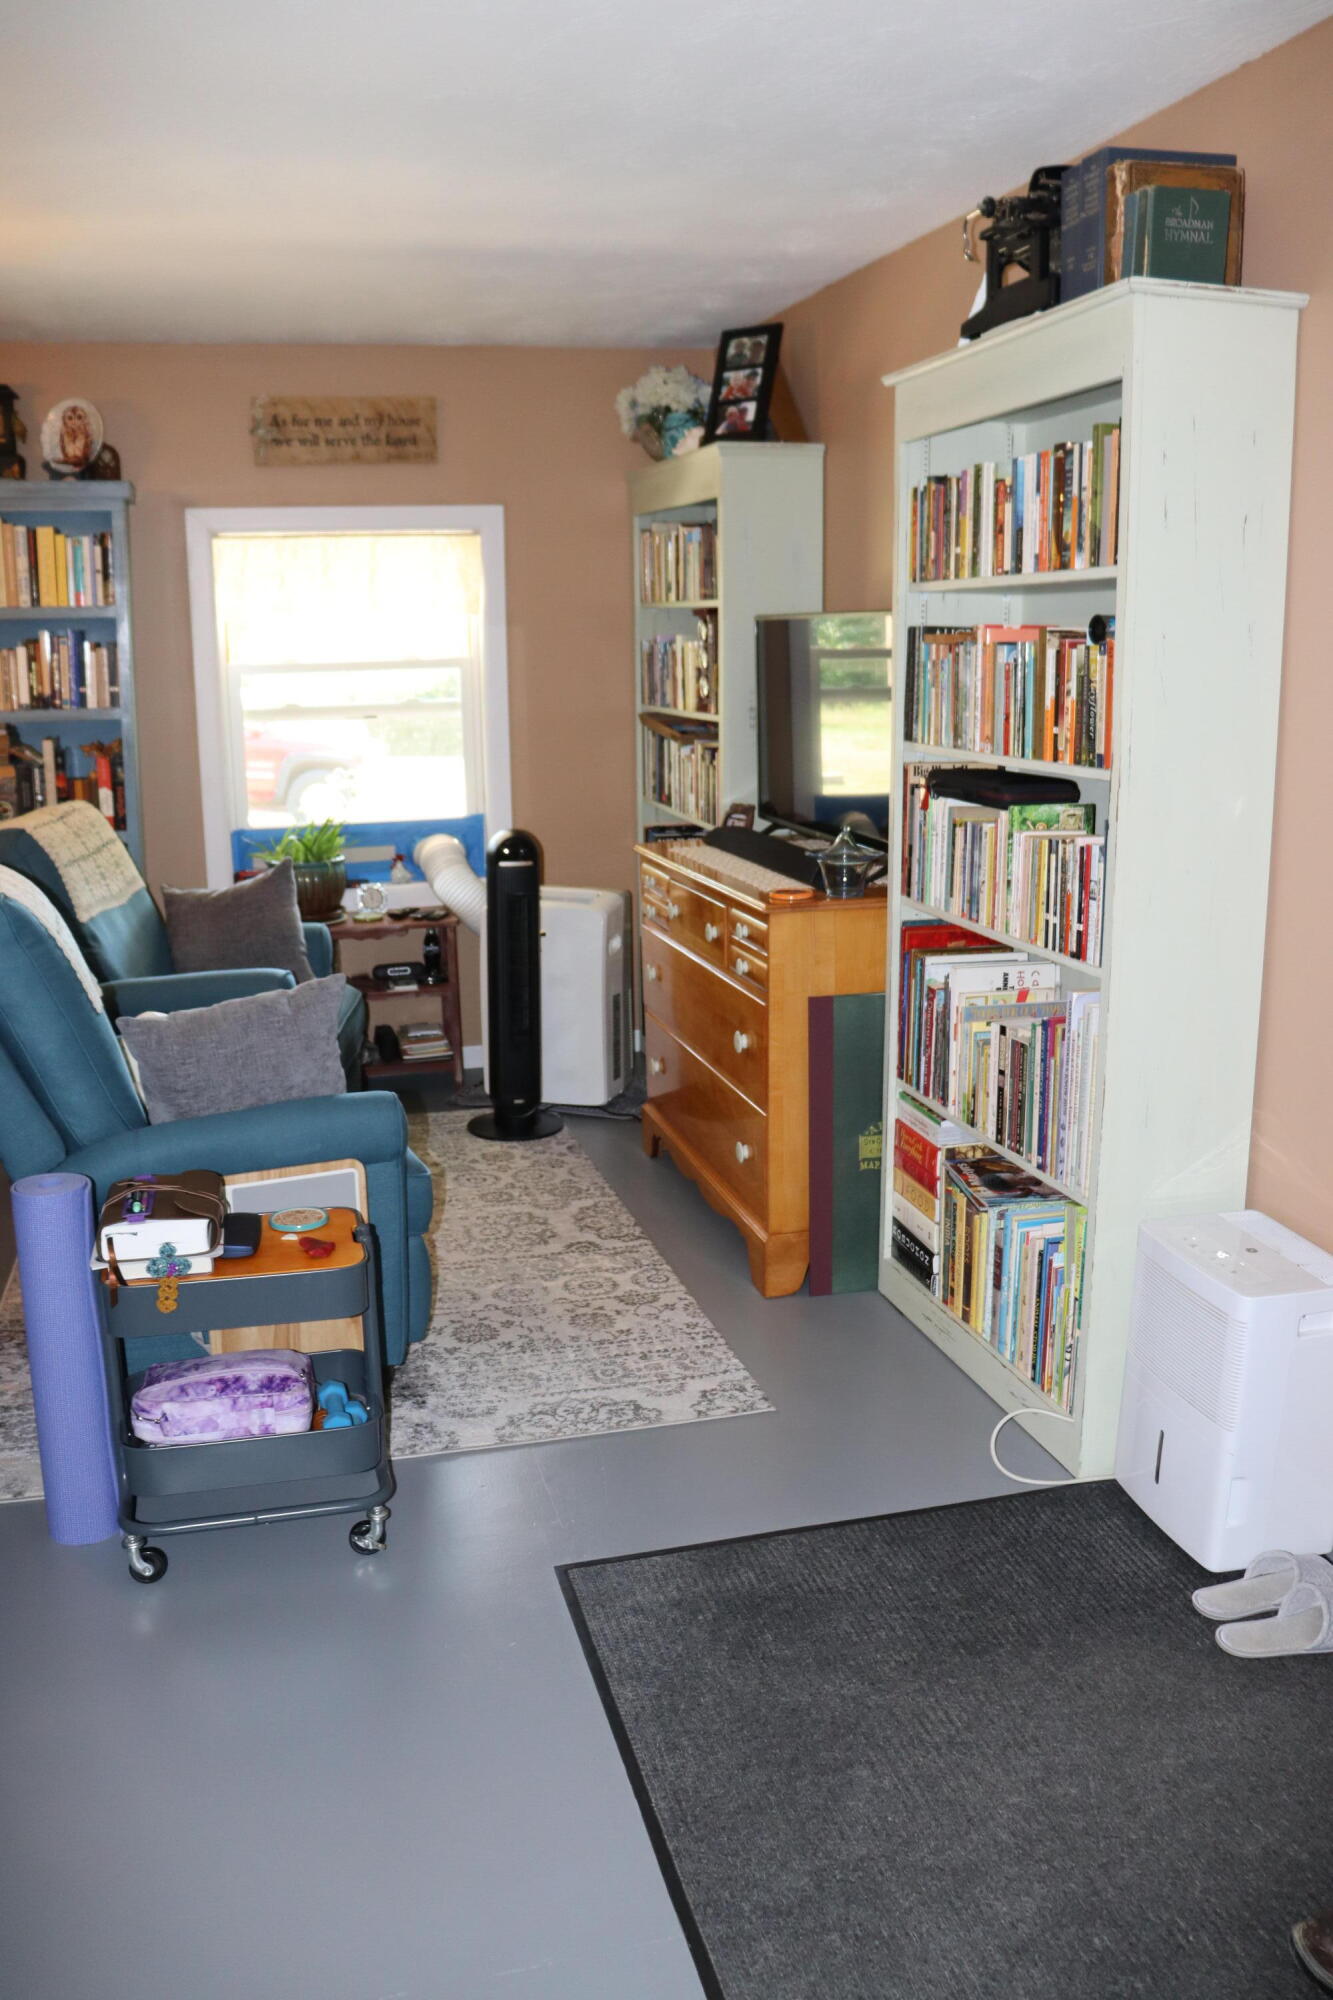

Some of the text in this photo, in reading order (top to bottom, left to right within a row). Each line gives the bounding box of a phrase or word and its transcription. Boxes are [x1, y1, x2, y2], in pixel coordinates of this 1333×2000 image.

[1165, 217, 1214, 231] BROADMAN
[1164, 228, 1214, 244] HYMNAL
[270, 413, 422, 431] As for me and my house
[298, 433, 321, 447] will
[325, 436, 358, 448] serve
[360, 433, 381, 447] the
[913, 764, 929, 778] Big
